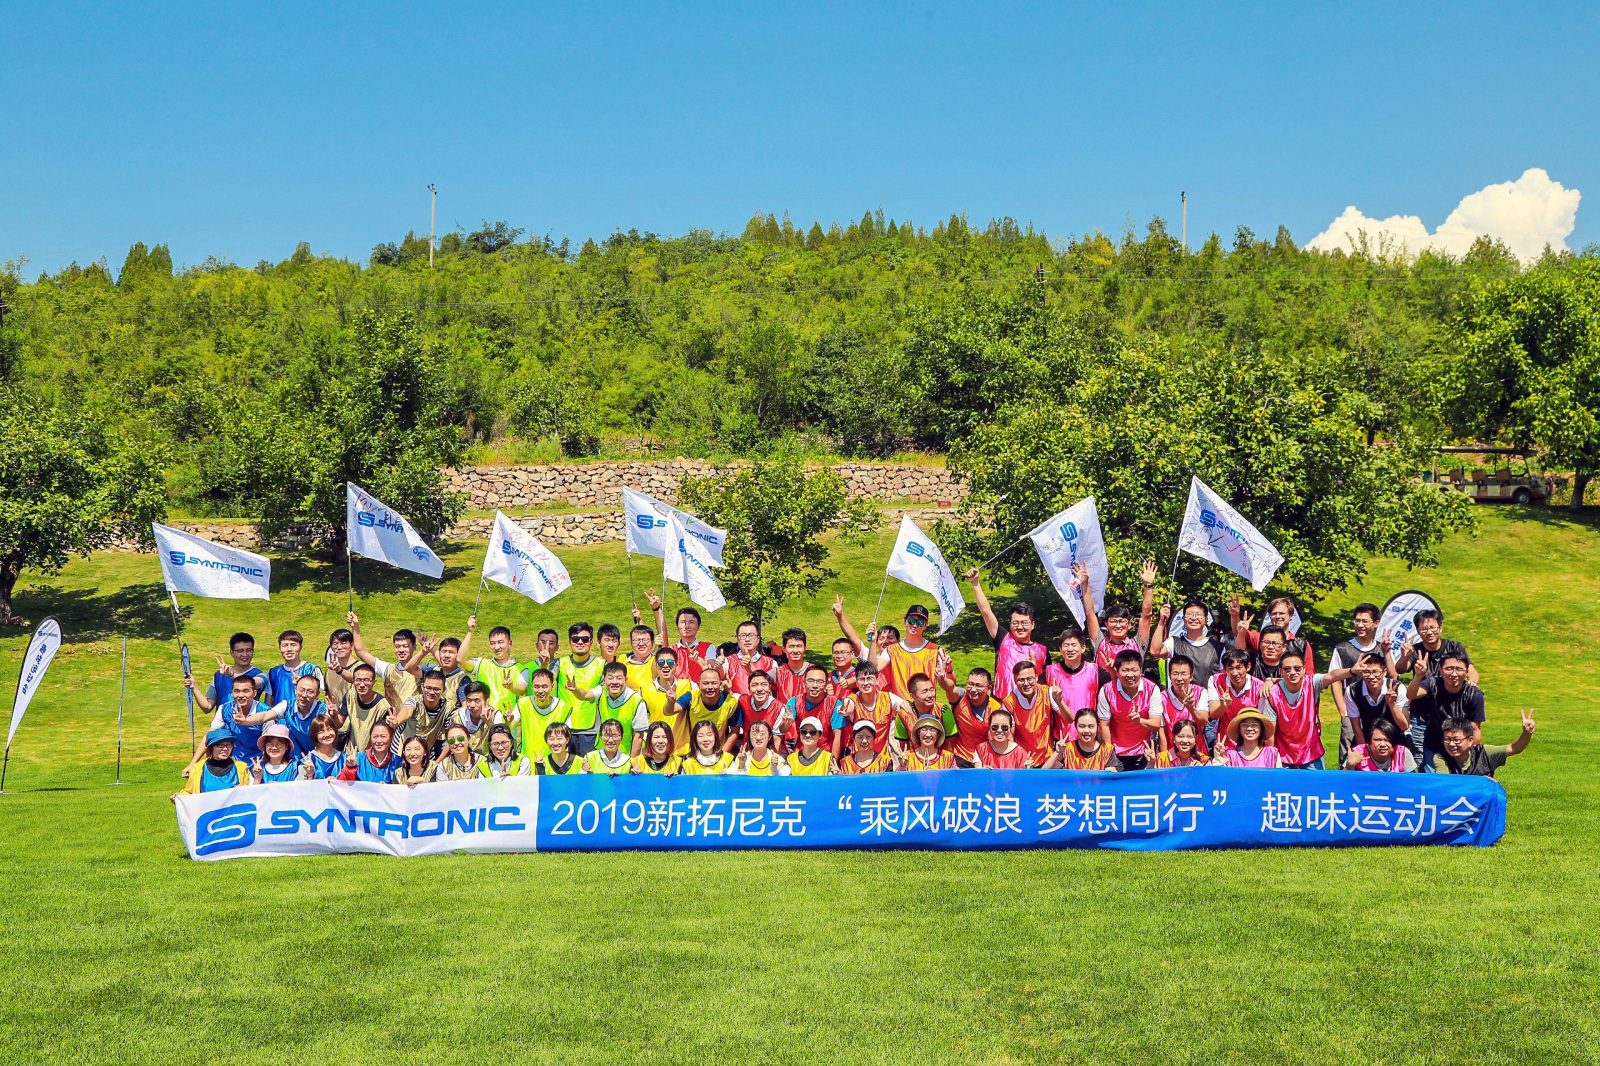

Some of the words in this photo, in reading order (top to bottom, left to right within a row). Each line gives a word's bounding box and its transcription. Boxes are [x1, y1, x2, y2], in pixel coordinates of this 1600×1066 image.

[186, 556, 264, 577] SYNTRONIC
[259, 806, 526, 839] SYNTRONIC
[550, 796, 807, 837] 2019新拓尼克
[1260, 790, 1481, 837] 趣味运动会
